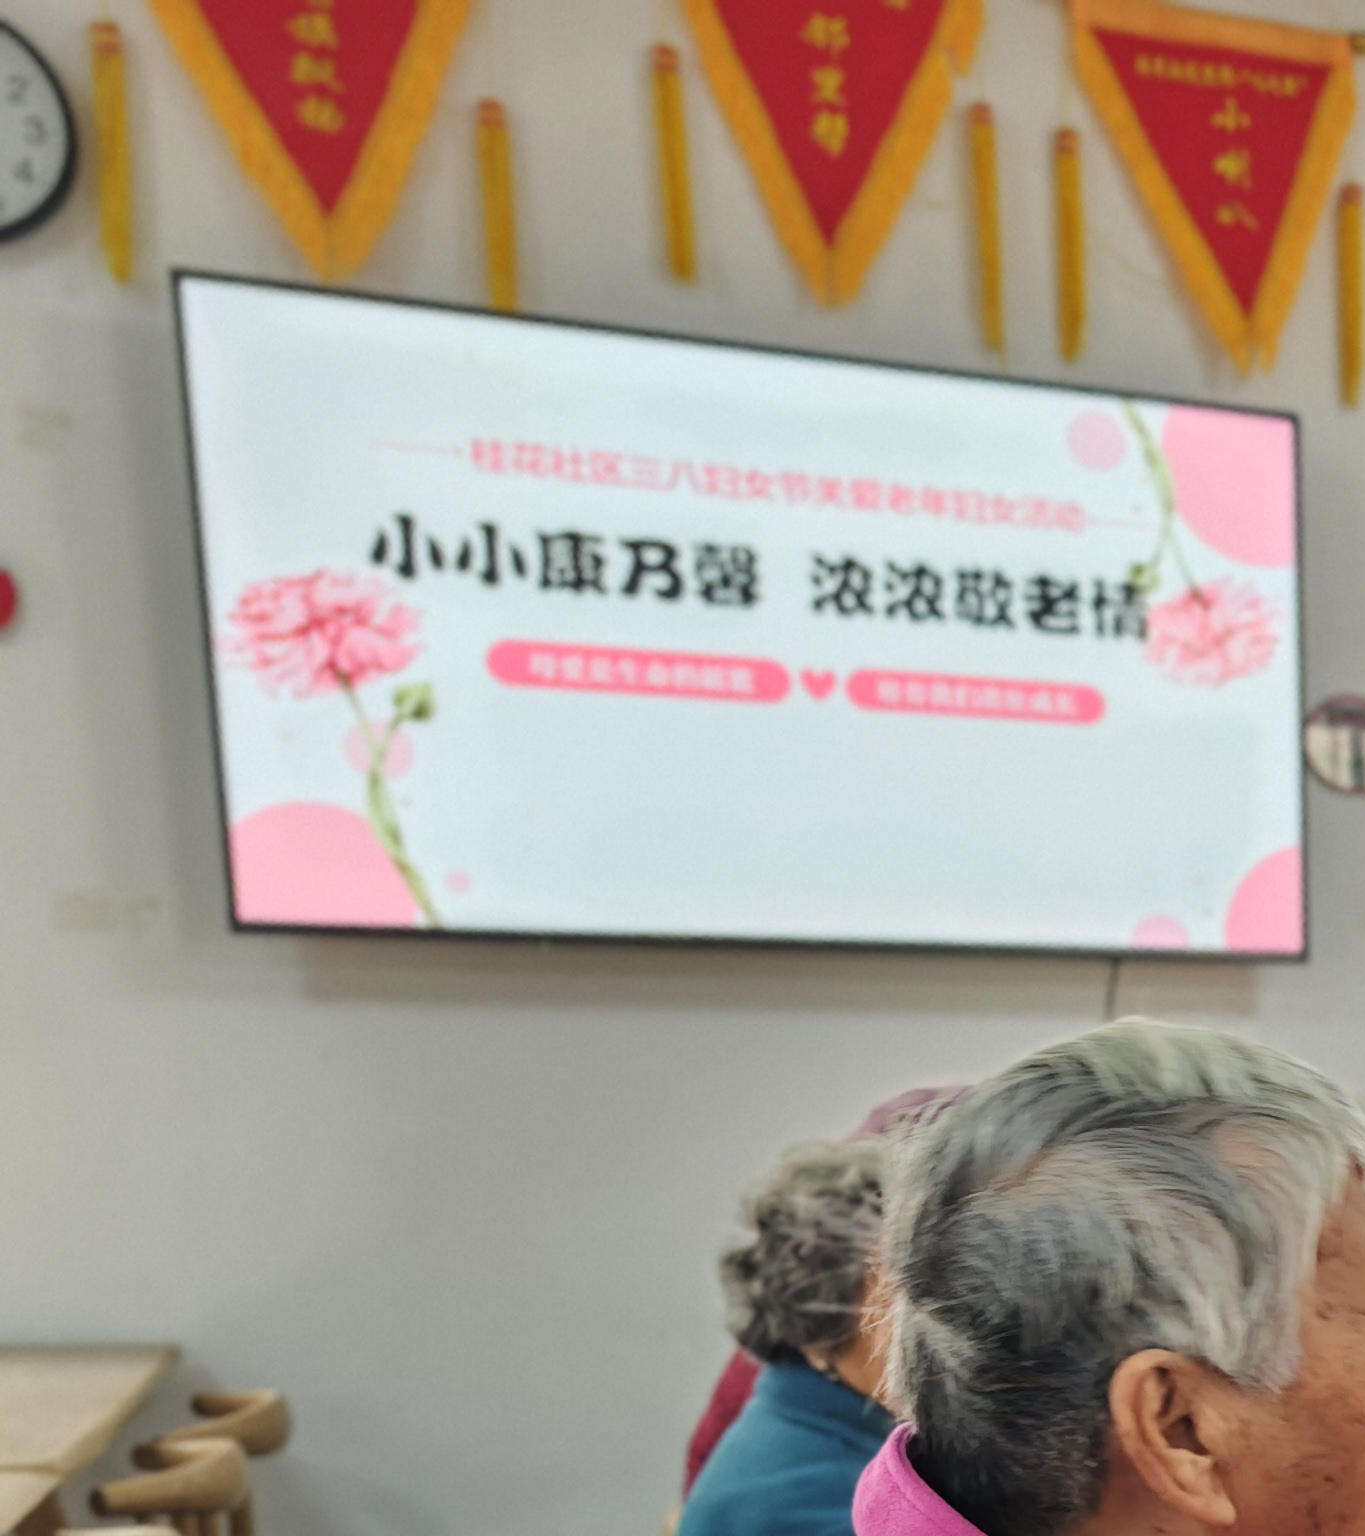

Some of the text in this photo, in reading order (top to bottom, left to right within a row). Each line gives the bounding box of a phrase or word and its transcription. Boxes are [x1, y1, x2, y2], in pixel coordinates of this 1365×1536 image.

[369, 513, 1148, 640] 小小康乃馨 浓浓敬老情
